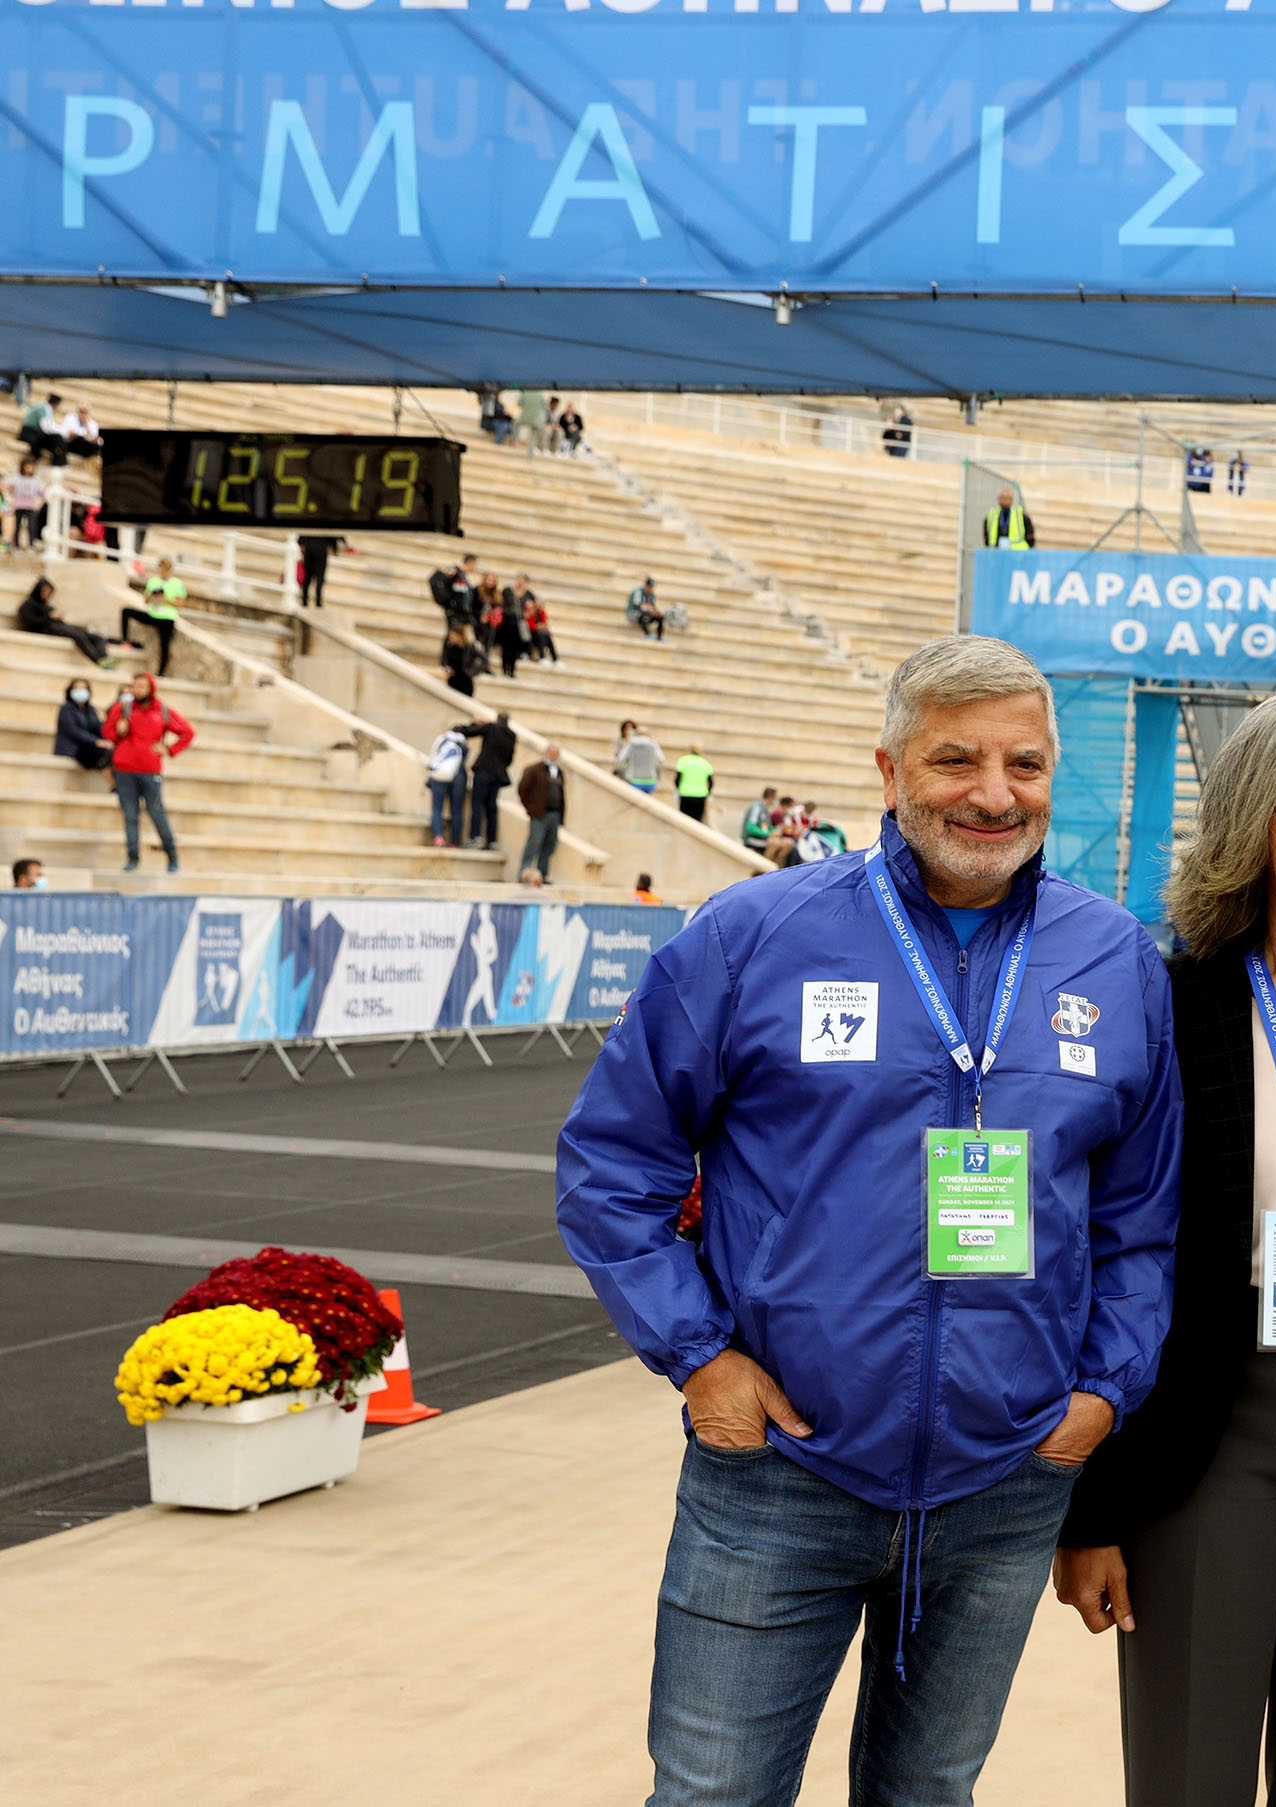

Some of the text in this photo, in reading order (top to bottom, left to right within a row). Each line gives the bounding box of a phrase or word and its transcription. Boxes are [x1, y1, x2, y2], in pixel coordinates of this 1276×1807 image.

[1110, 619, 1149, 655] Ο
[876, 874, 888, 892] 2021
[938, 1176, 1014, 1184] ATHENS MARATHON
